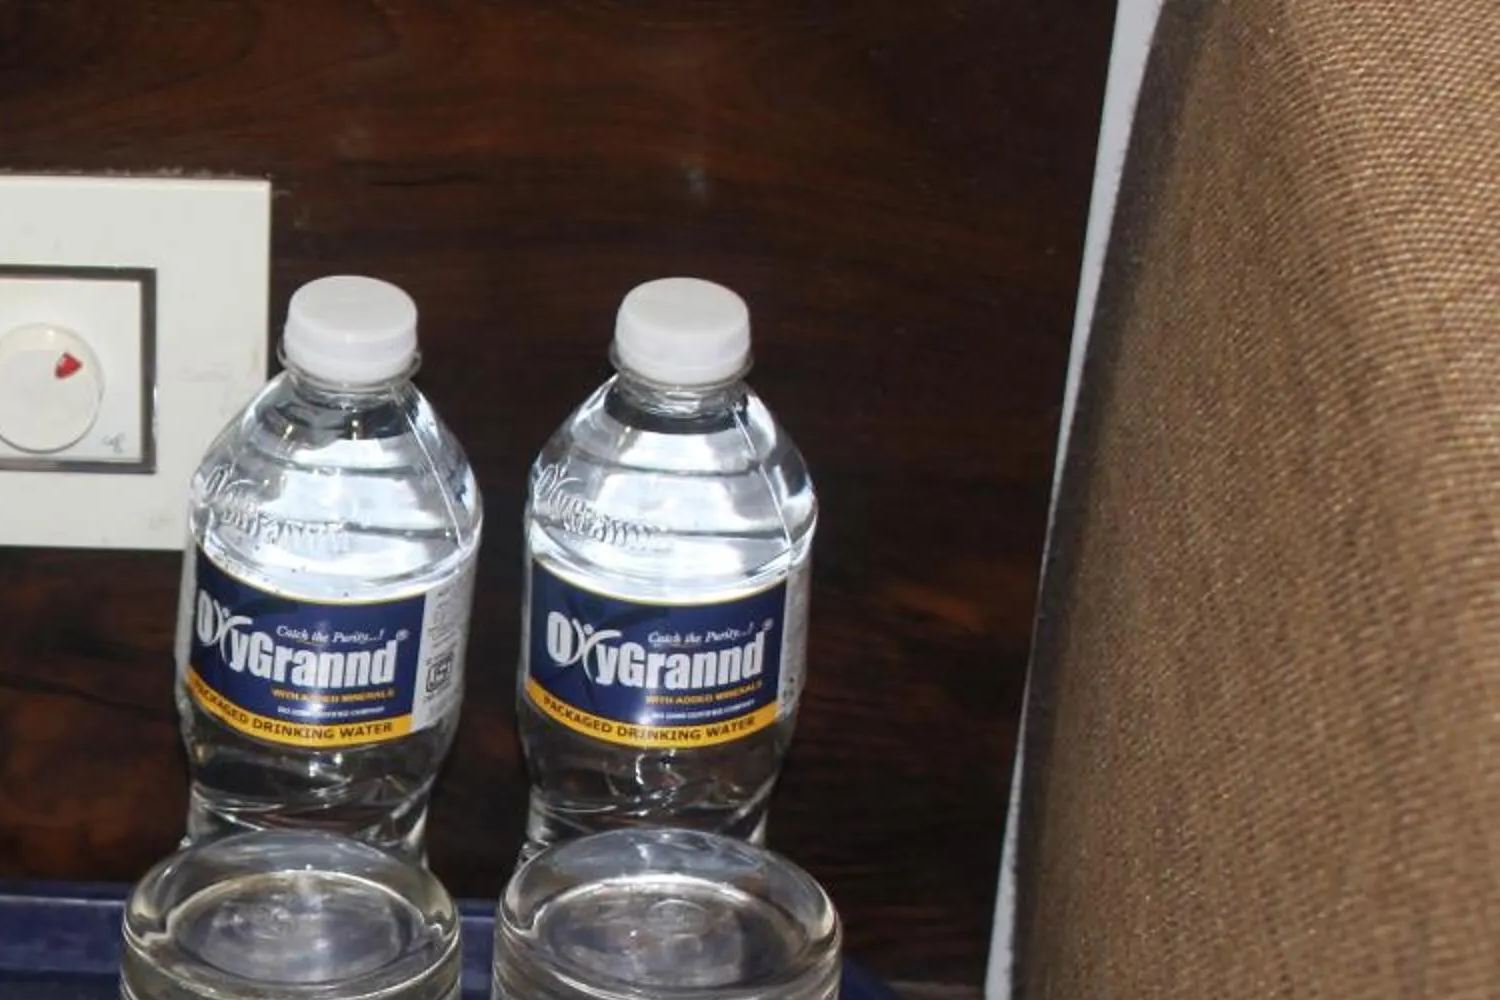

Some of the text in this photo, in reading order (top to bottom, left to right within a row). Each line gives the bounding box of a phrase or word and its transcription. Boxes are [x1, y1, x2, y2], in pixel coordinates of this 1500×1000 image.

[276, 625, 308, 640] Catch
[251, 718, 336, 740] DRINKING
[339, 721, 393, 738] WATER
[542, 695, 756, 742] PACKAGED DRINKING WATER
